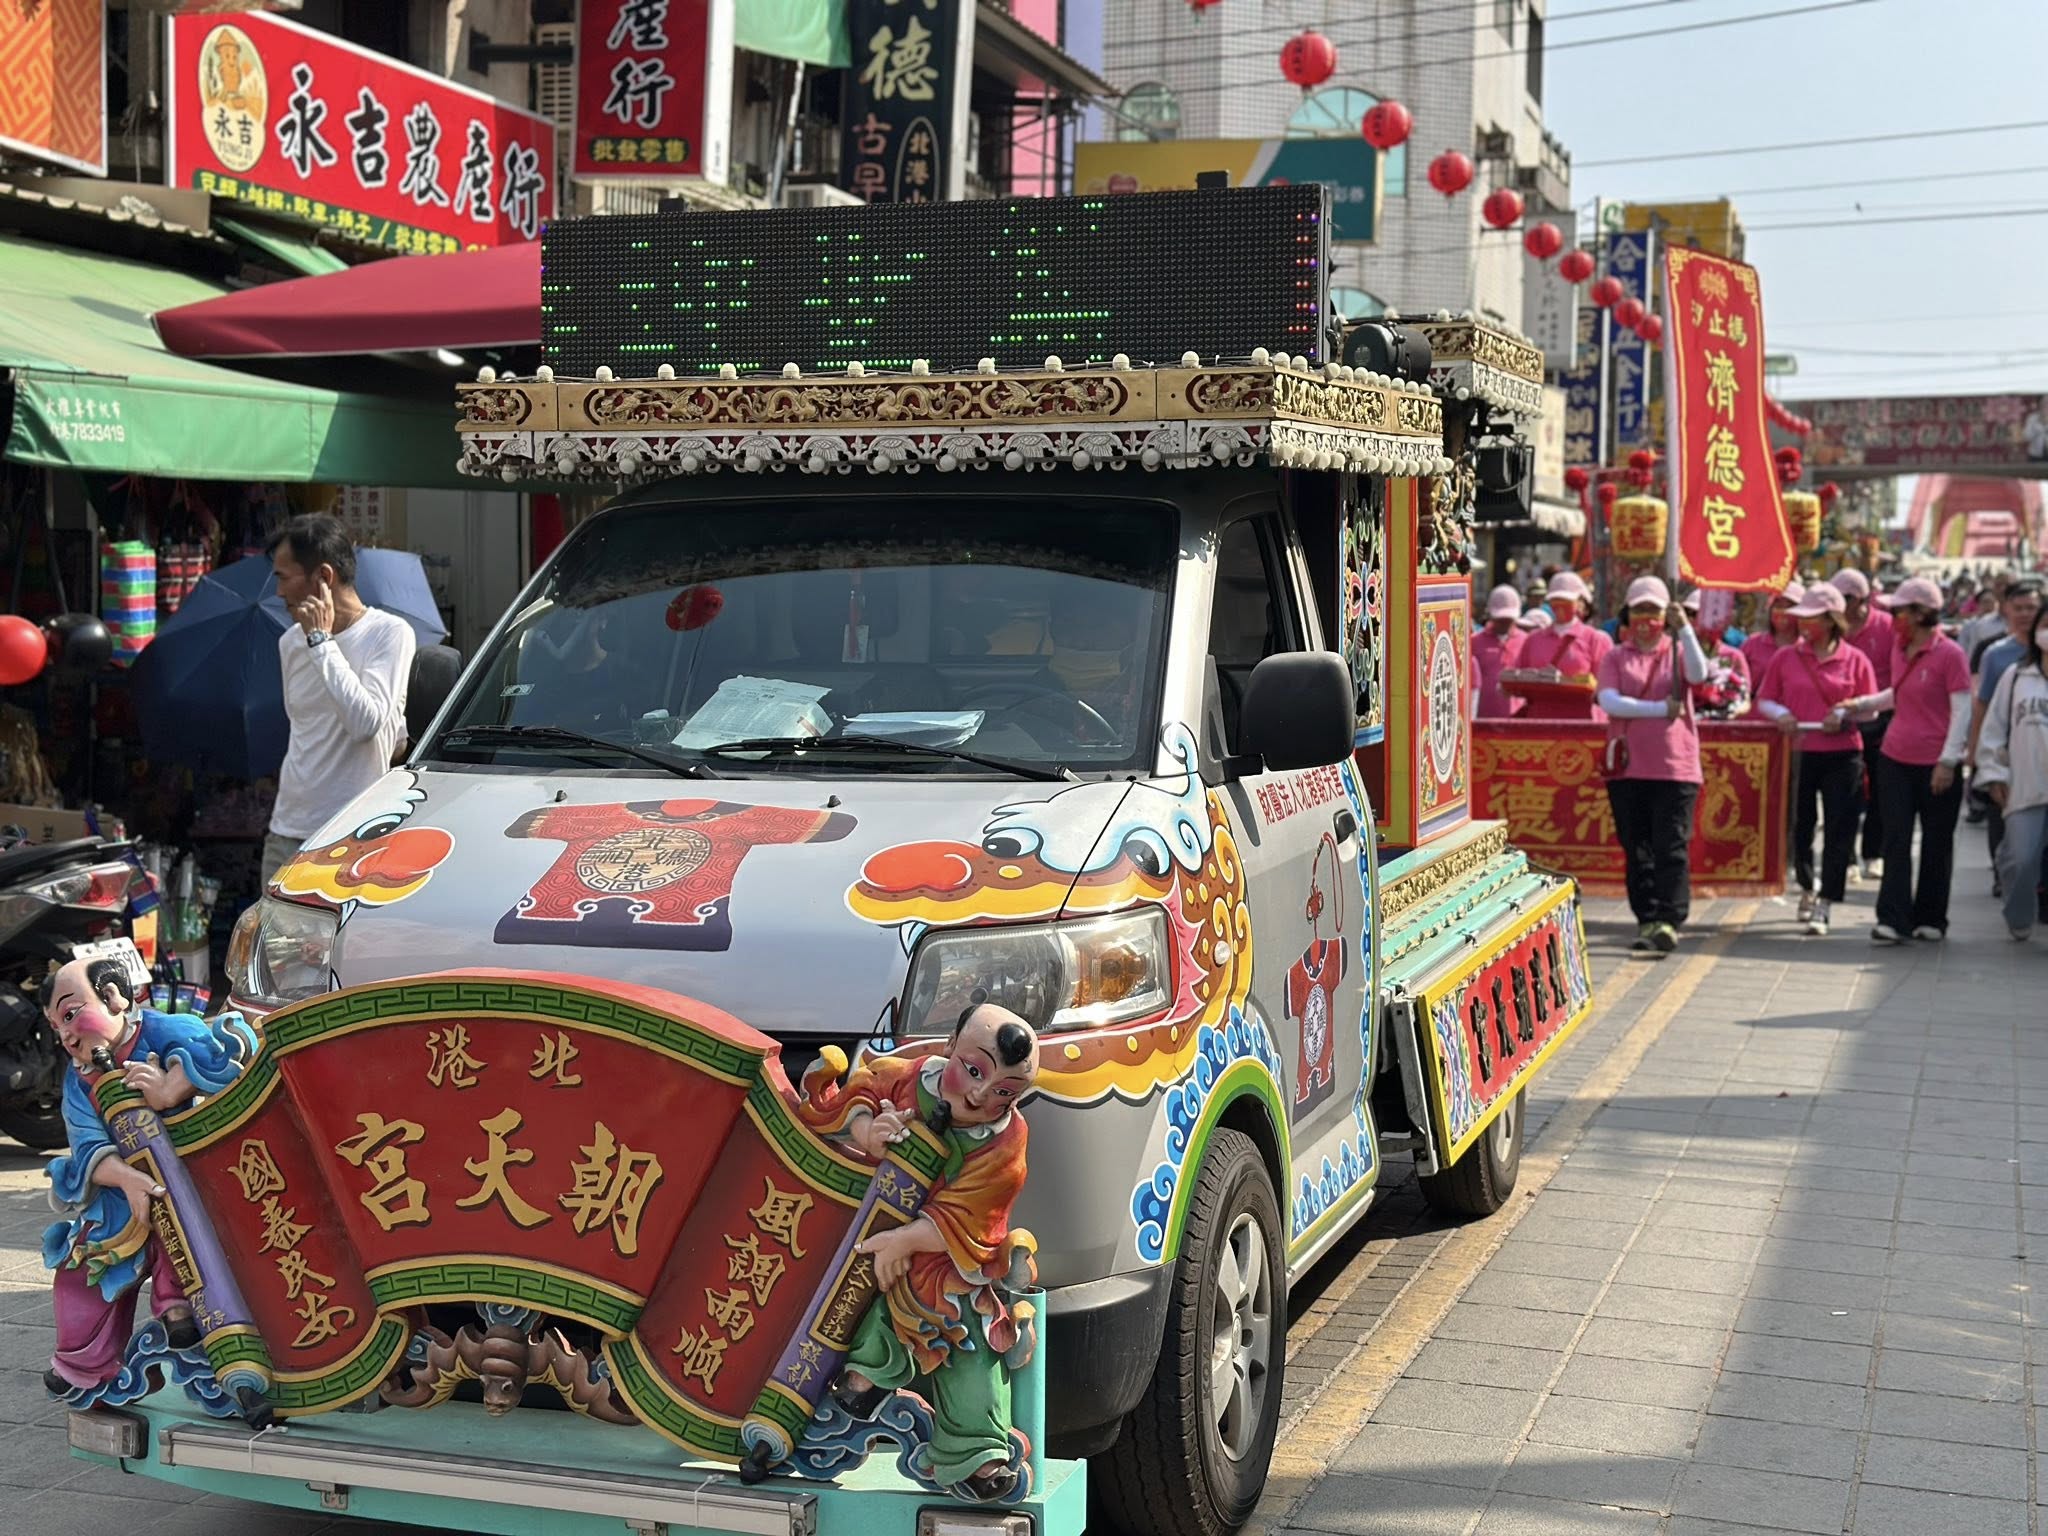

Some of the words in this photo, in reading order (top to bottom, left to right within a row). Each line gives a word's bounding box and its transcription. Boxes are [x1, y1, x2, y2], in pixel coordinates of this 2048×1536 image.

[214, 107, 253, 145] 永吉
[275, 63, 545, 240] 永吉農產行
[1703, 350, 1746, 560] 濟德宮
[227, 1139, 355, 1348] 國泰民安
[672, 1175, 814, 1395] 風調雨順
